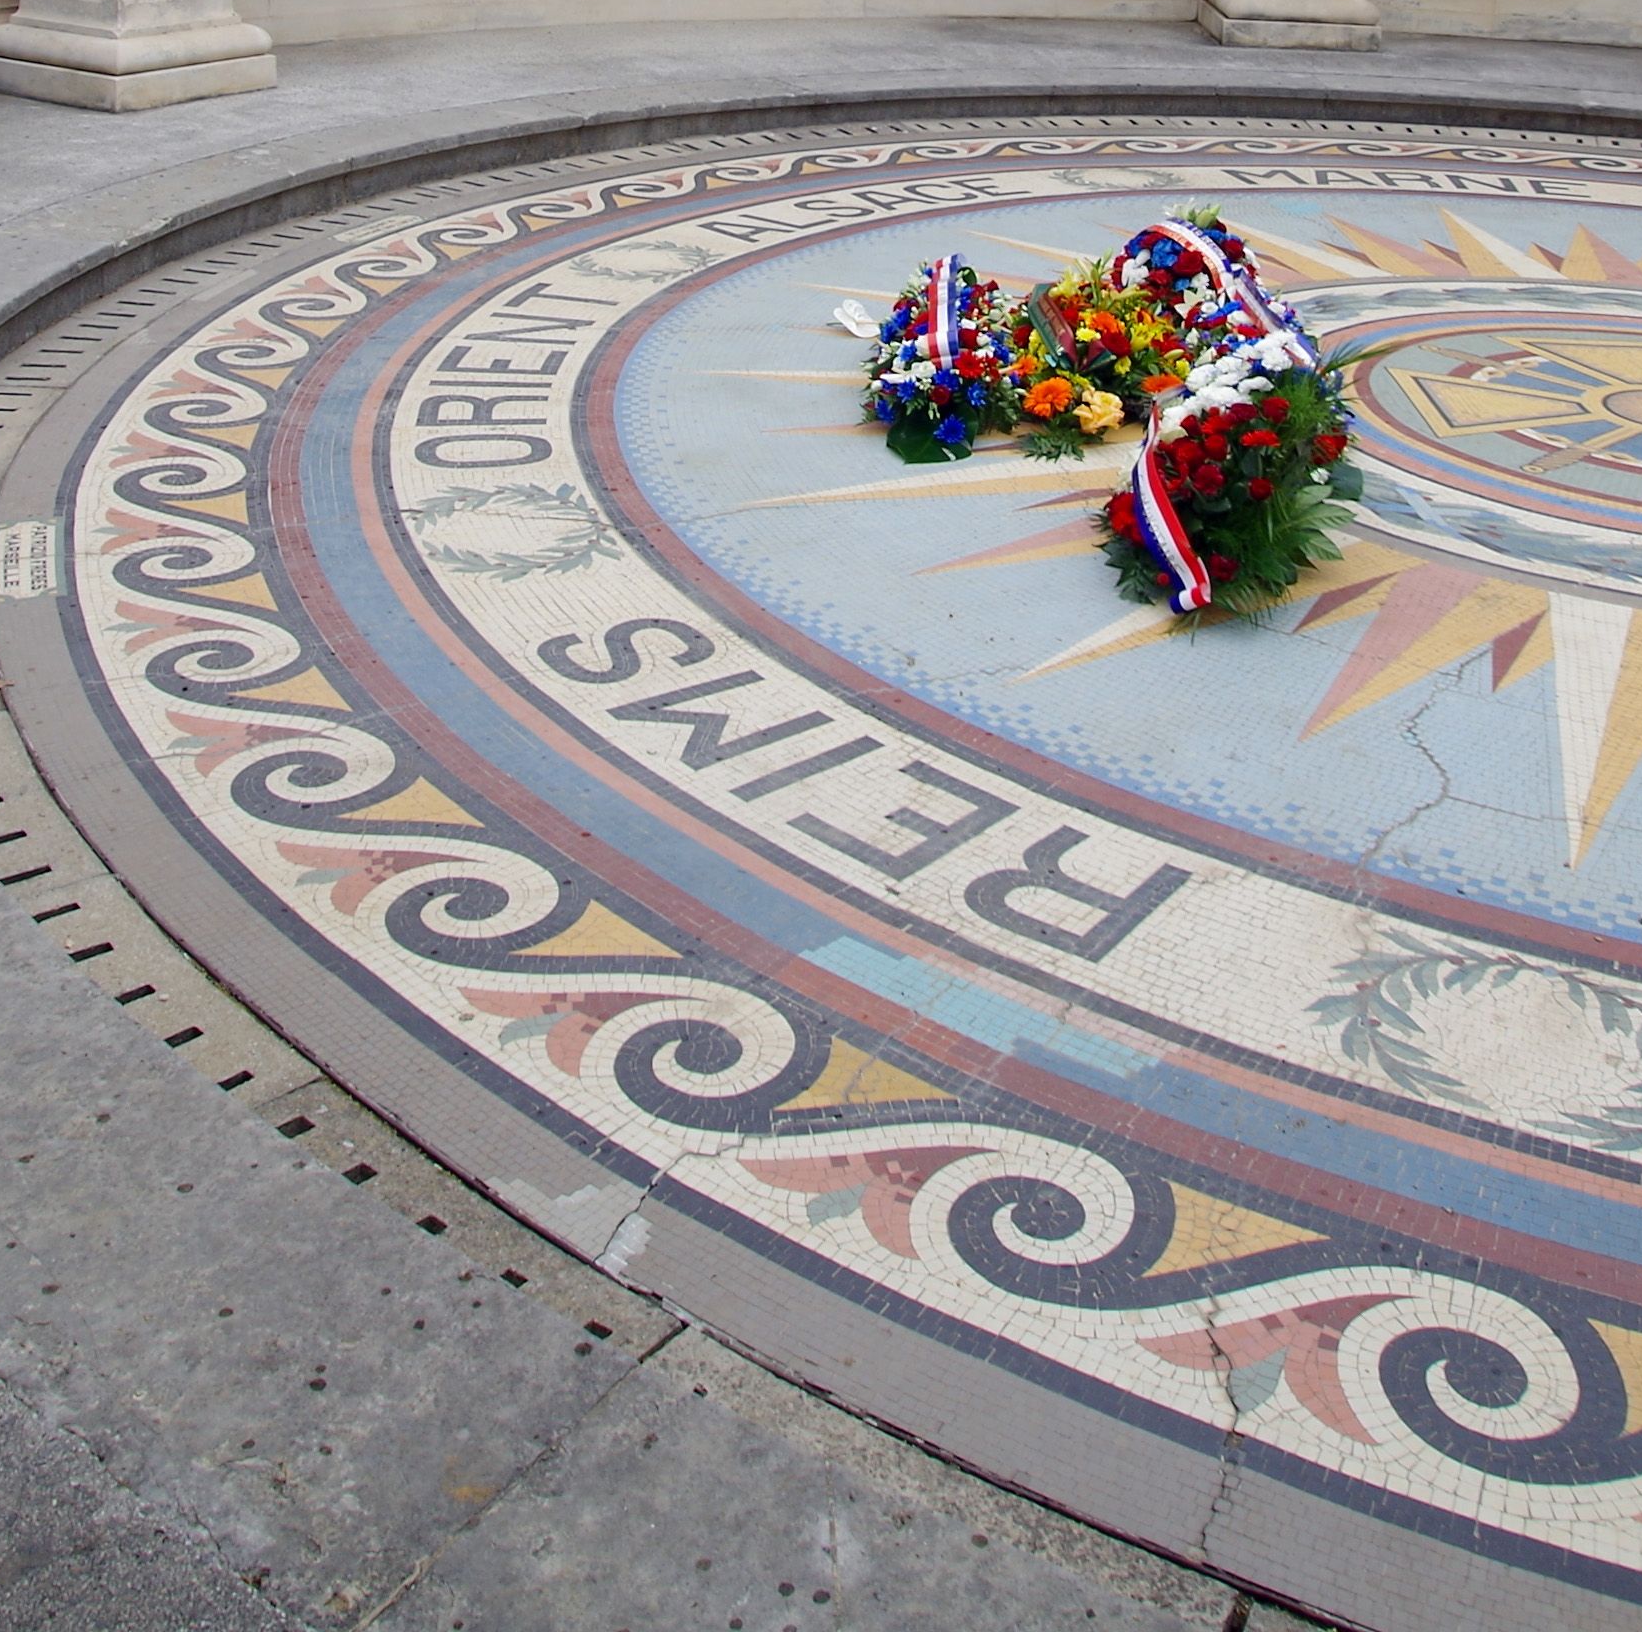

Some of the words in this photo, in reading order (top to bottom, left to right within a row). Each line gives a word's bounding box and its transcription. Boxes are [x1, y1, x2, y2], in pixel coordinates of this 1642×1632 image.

[698, 177, 1032, 243] ALSACE
[1221, 169, 1591, 198] MARNE
[414, 282, 620, 469] ORIENT
[536, 615, 1193, 962] REIMS
